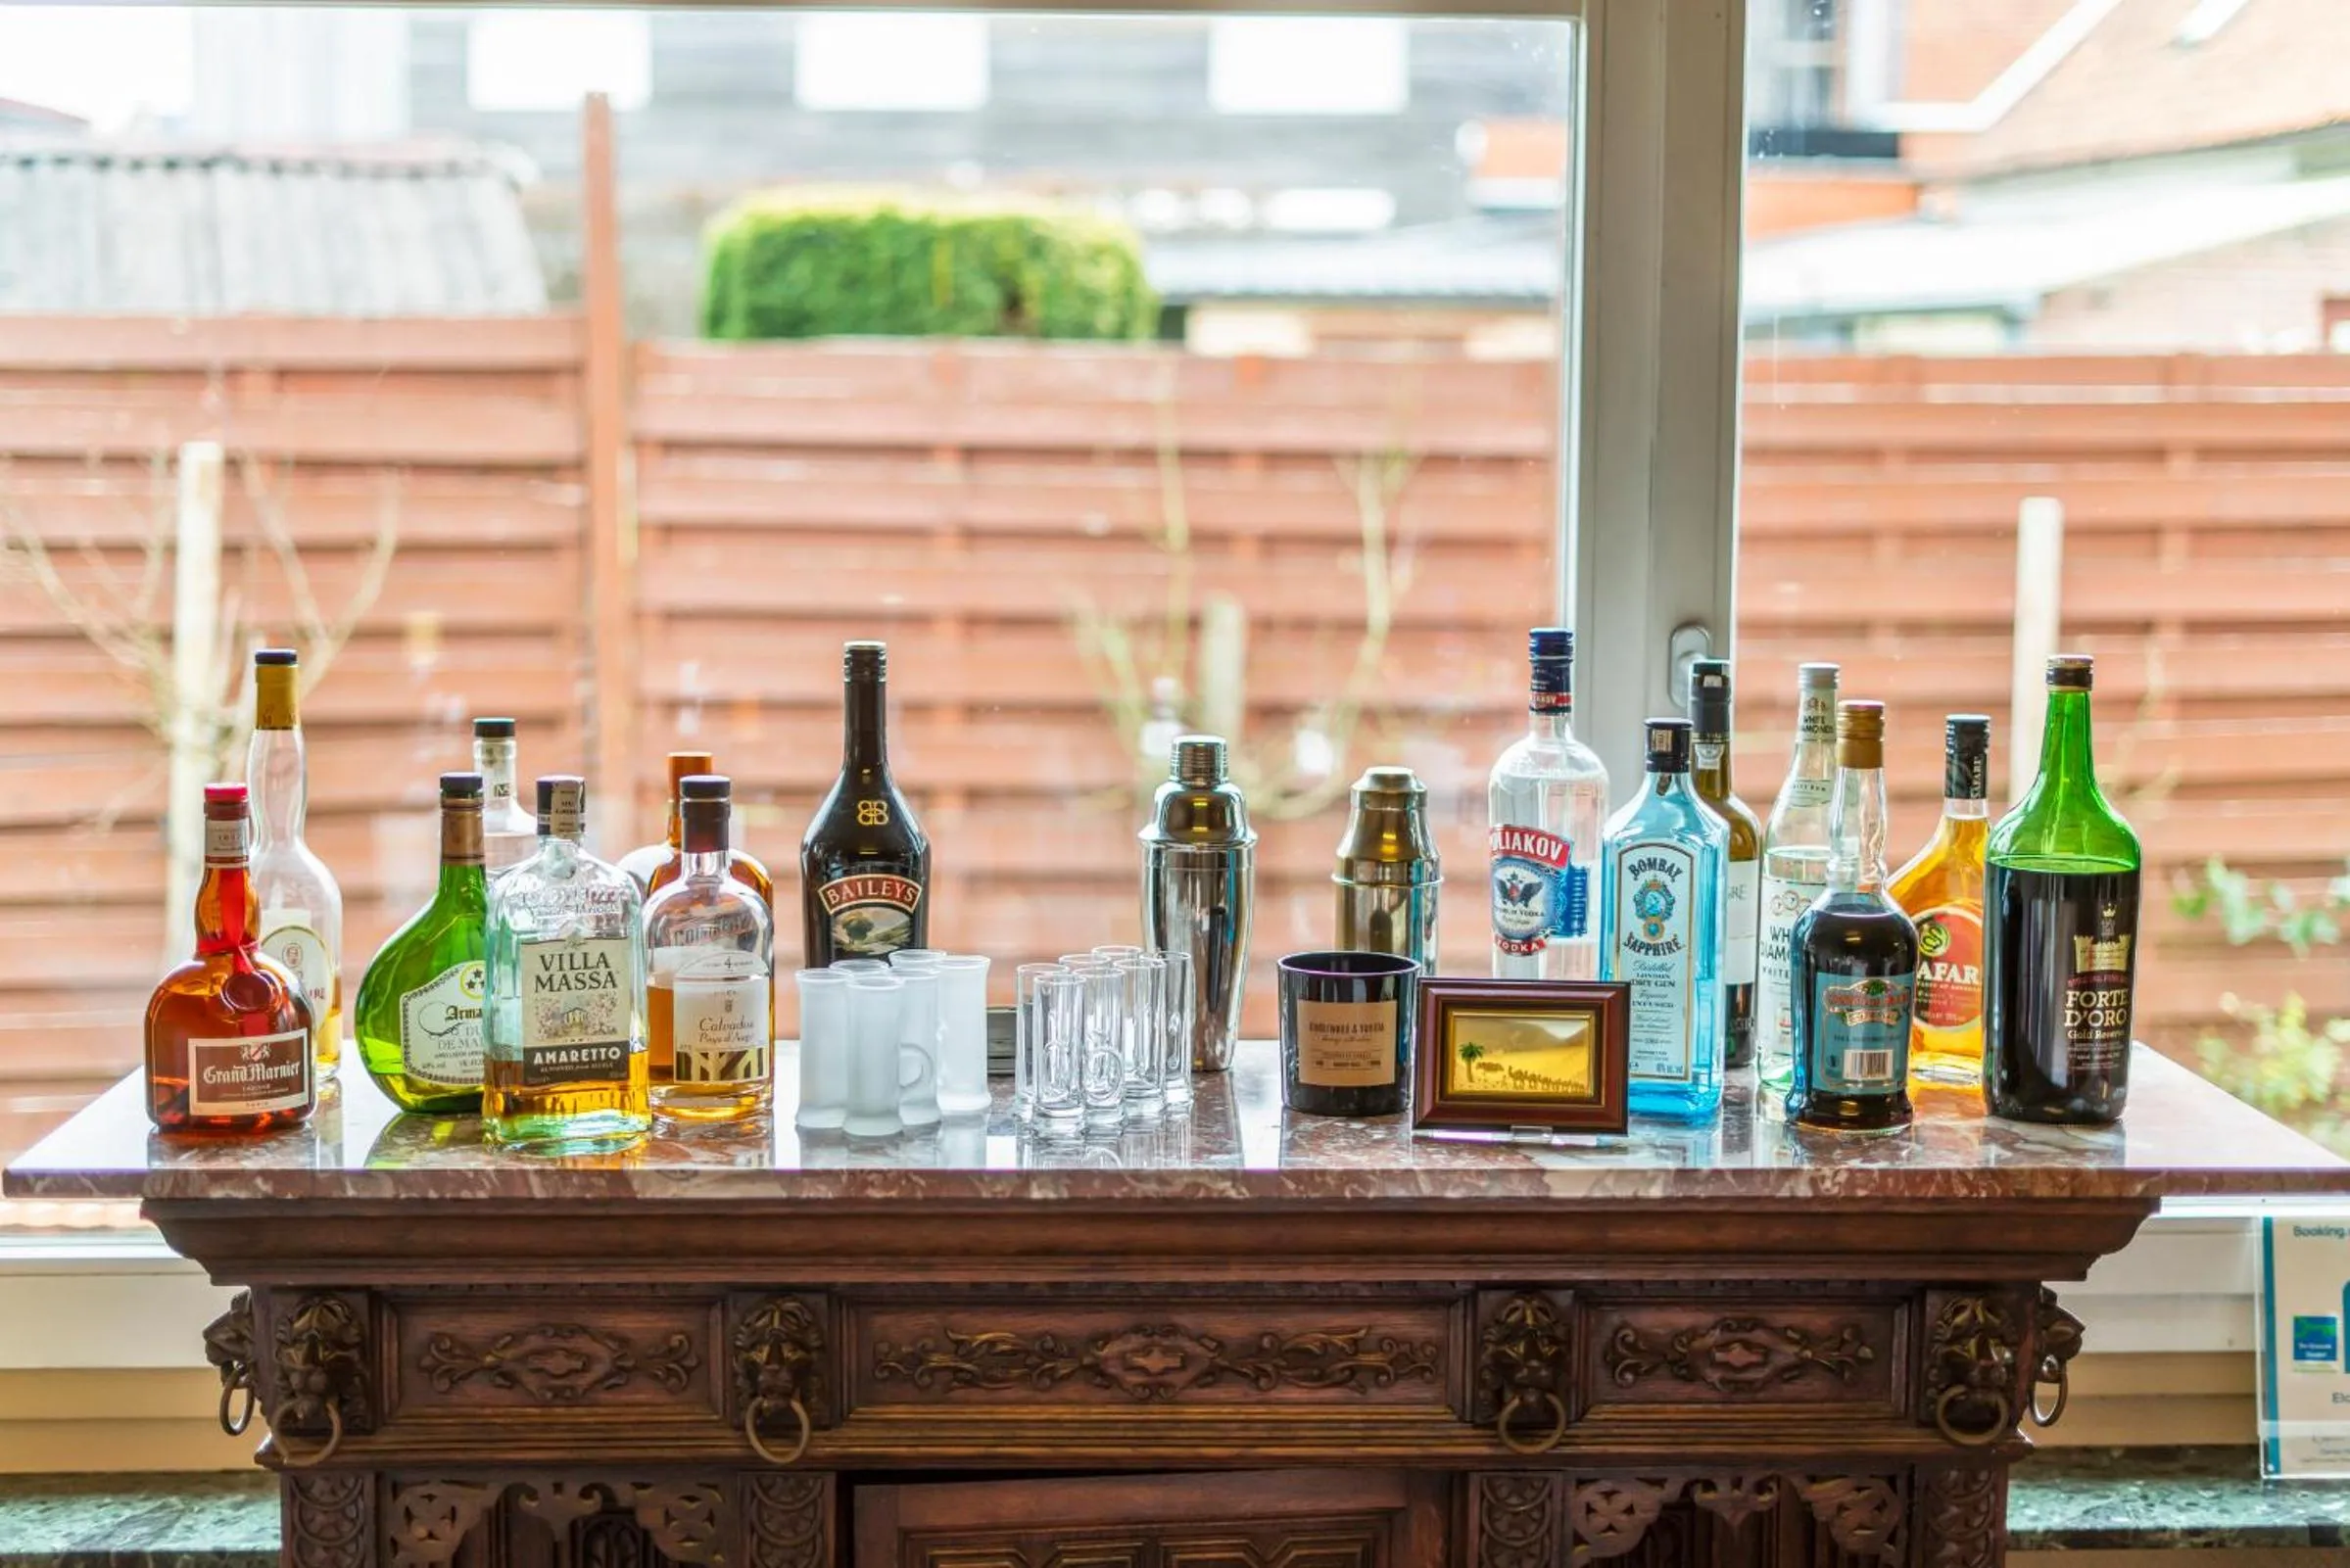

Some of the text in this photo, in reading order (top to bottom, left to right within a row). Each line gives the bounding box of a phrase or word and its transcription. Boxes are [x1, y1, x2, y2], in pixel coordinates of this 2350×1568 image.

[1628, 857, 1683, 882] BOMBAY
[826, 879, 917, 905] BAILEYS
[1622, 931, 1682, 957] SAPPHIRE
[1770, 925, 1791, 942] WH
[540, 952, 610, 973] VILLA
[724, 956, 734, 969] 4
[1916, 961, 1983, 985] AFAR
[535, 971, 618, 993] MASSA
[2066, 988, 2129, 1009] FORTE
[445, 1005, 483, 1022] Arma
[2064, 1009, 2127, 1027] D'ORO
[2067, 1029, 2092, 1040] Gold
[533, 1046, 621, 1066] AMARETTO
[203, 1060, 301, 1085] Grand Marnier
